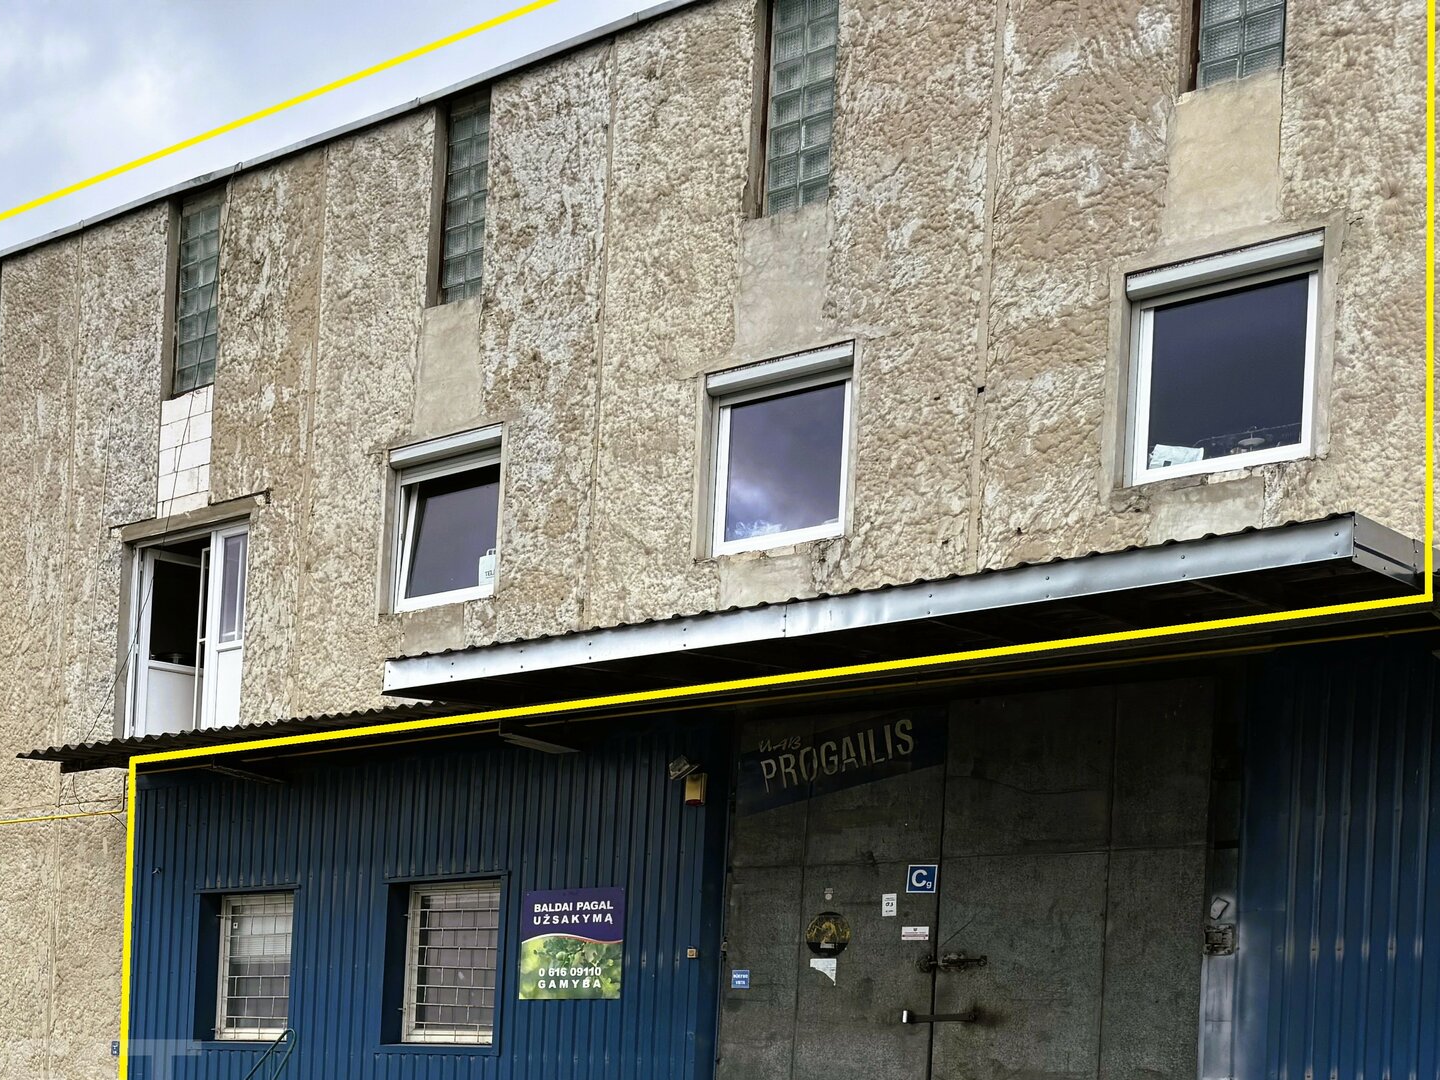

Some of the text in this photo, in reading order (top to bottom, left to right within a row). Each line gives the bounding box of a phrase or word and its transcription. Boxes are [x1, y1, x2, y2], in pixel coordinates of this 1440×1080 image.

[759, 735, 802, 753] UAB
[760, 719, 915, 794] PROGAILIS
[534, 900, 614, 913] BALDAI PAGAL
[533, 913, 614, 925] UŽSAKYMĄ
[538, 967, 602, 977] 0 616 09110
[538, 979, 601, 989] GAMYBA
